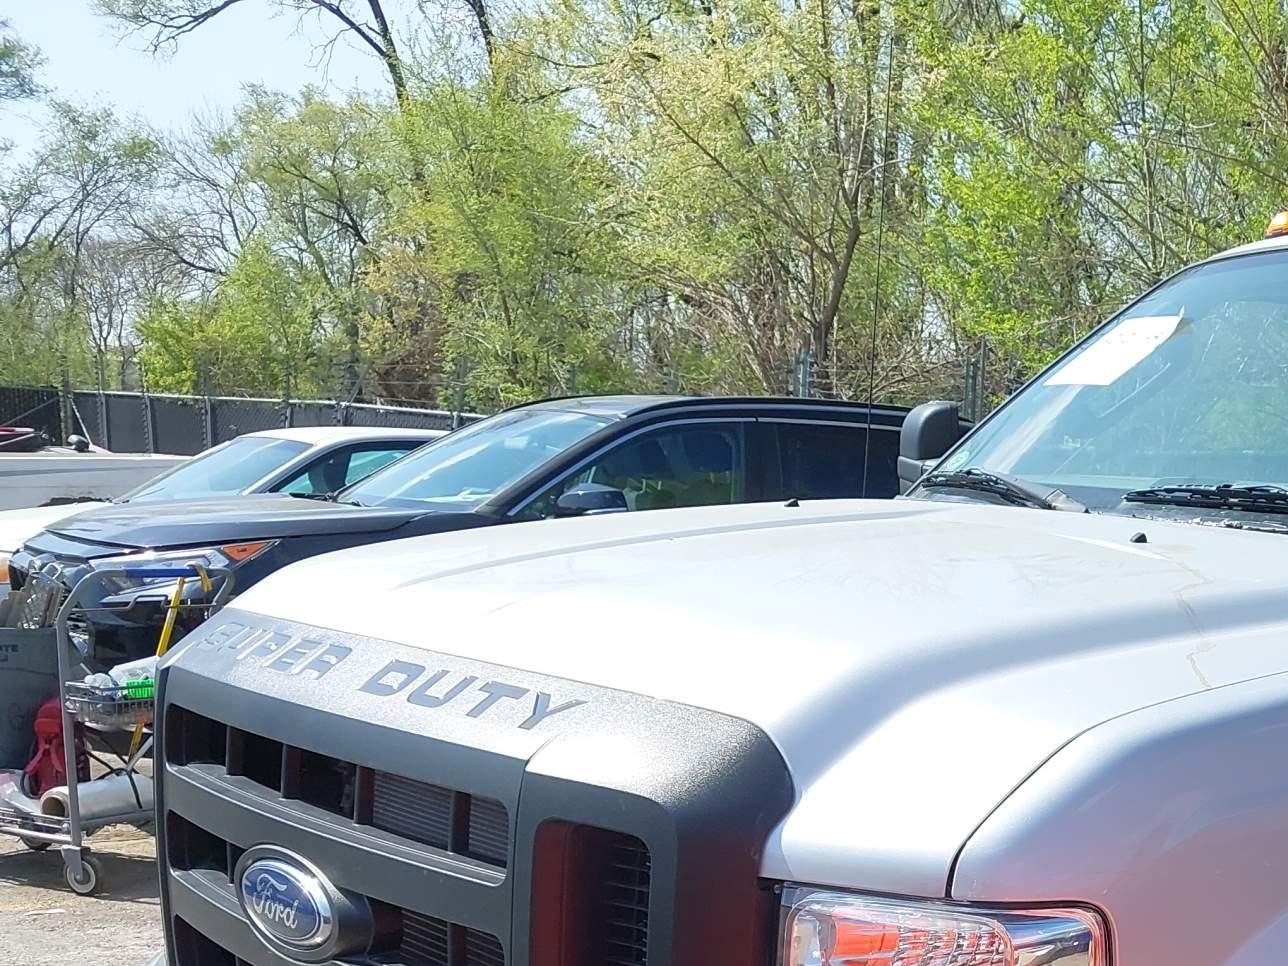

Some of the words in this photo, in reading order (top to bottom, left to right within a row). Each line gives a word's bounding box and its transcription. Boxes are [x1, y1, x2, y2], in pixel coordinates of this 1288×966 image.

[200, 621, 353, 681] SUPER
[357, 658, 589, 730] DUTY
[252, 873, 298, 930] Ford
